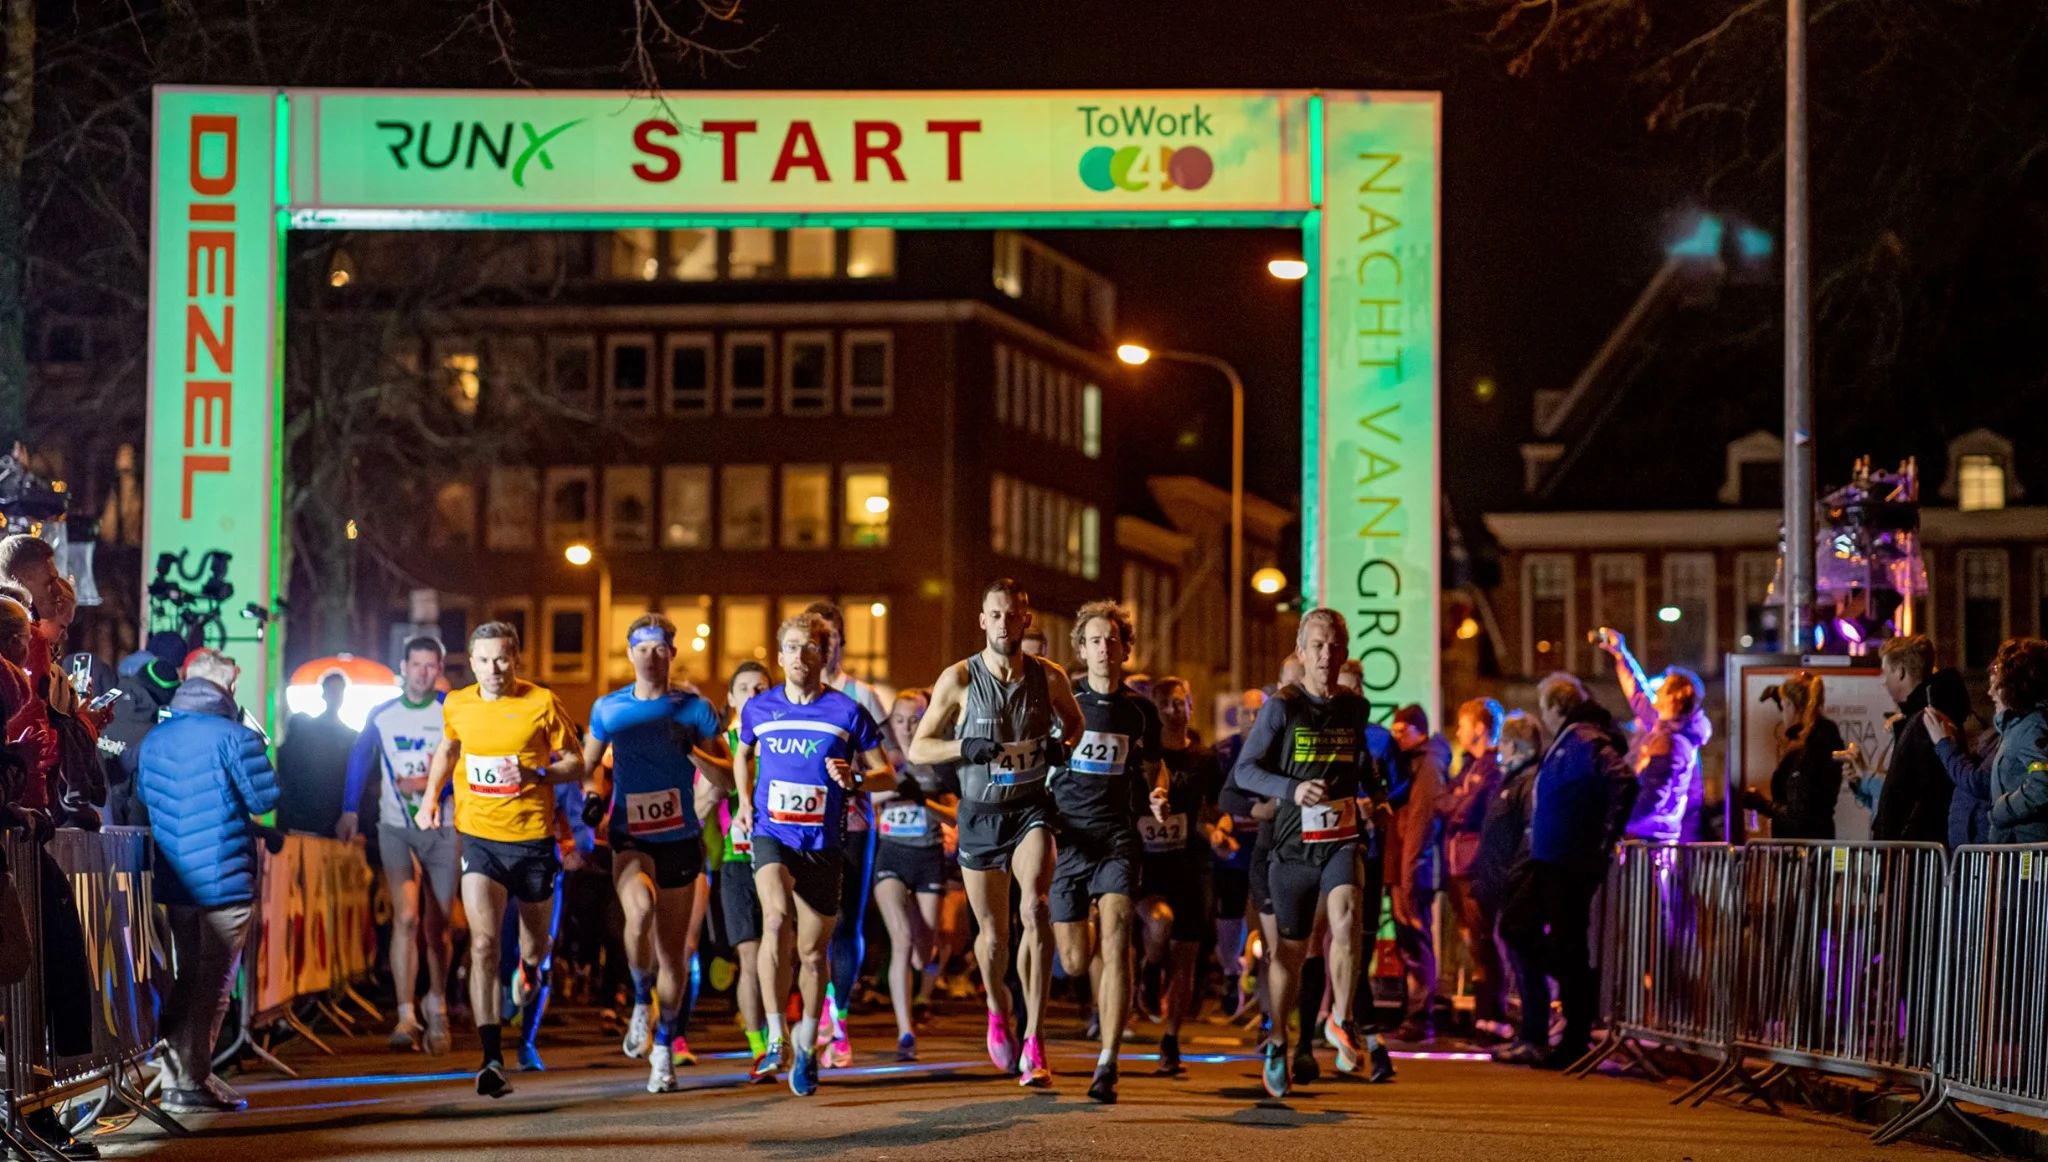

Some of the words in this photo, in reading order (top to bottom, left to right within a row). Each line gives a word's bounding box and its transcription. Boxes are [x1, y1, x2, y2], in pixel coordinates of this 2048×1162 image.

[1077, 104, 1213, 137] ToWork
[376, 118, 588, 189] RUNX
[631, 119, 982, 183] START
[1358, 153, 1402, 384] NACHT
[181, 115, 238, 520] DIEZEL
[1358, 403, 1401, 538] VAN
[766, 736, 828, 759] RUNX
[1000, 747, 1045, 771] 417
[1081, 743, 1118, 762] 421
[474, 767, 504, 784] 16
[636, 801, 674, 821] 108
[780, 794, 817, 812] 120
[887, 811, 919, 824] 427
[1321, 809, 1344, 828] 17
